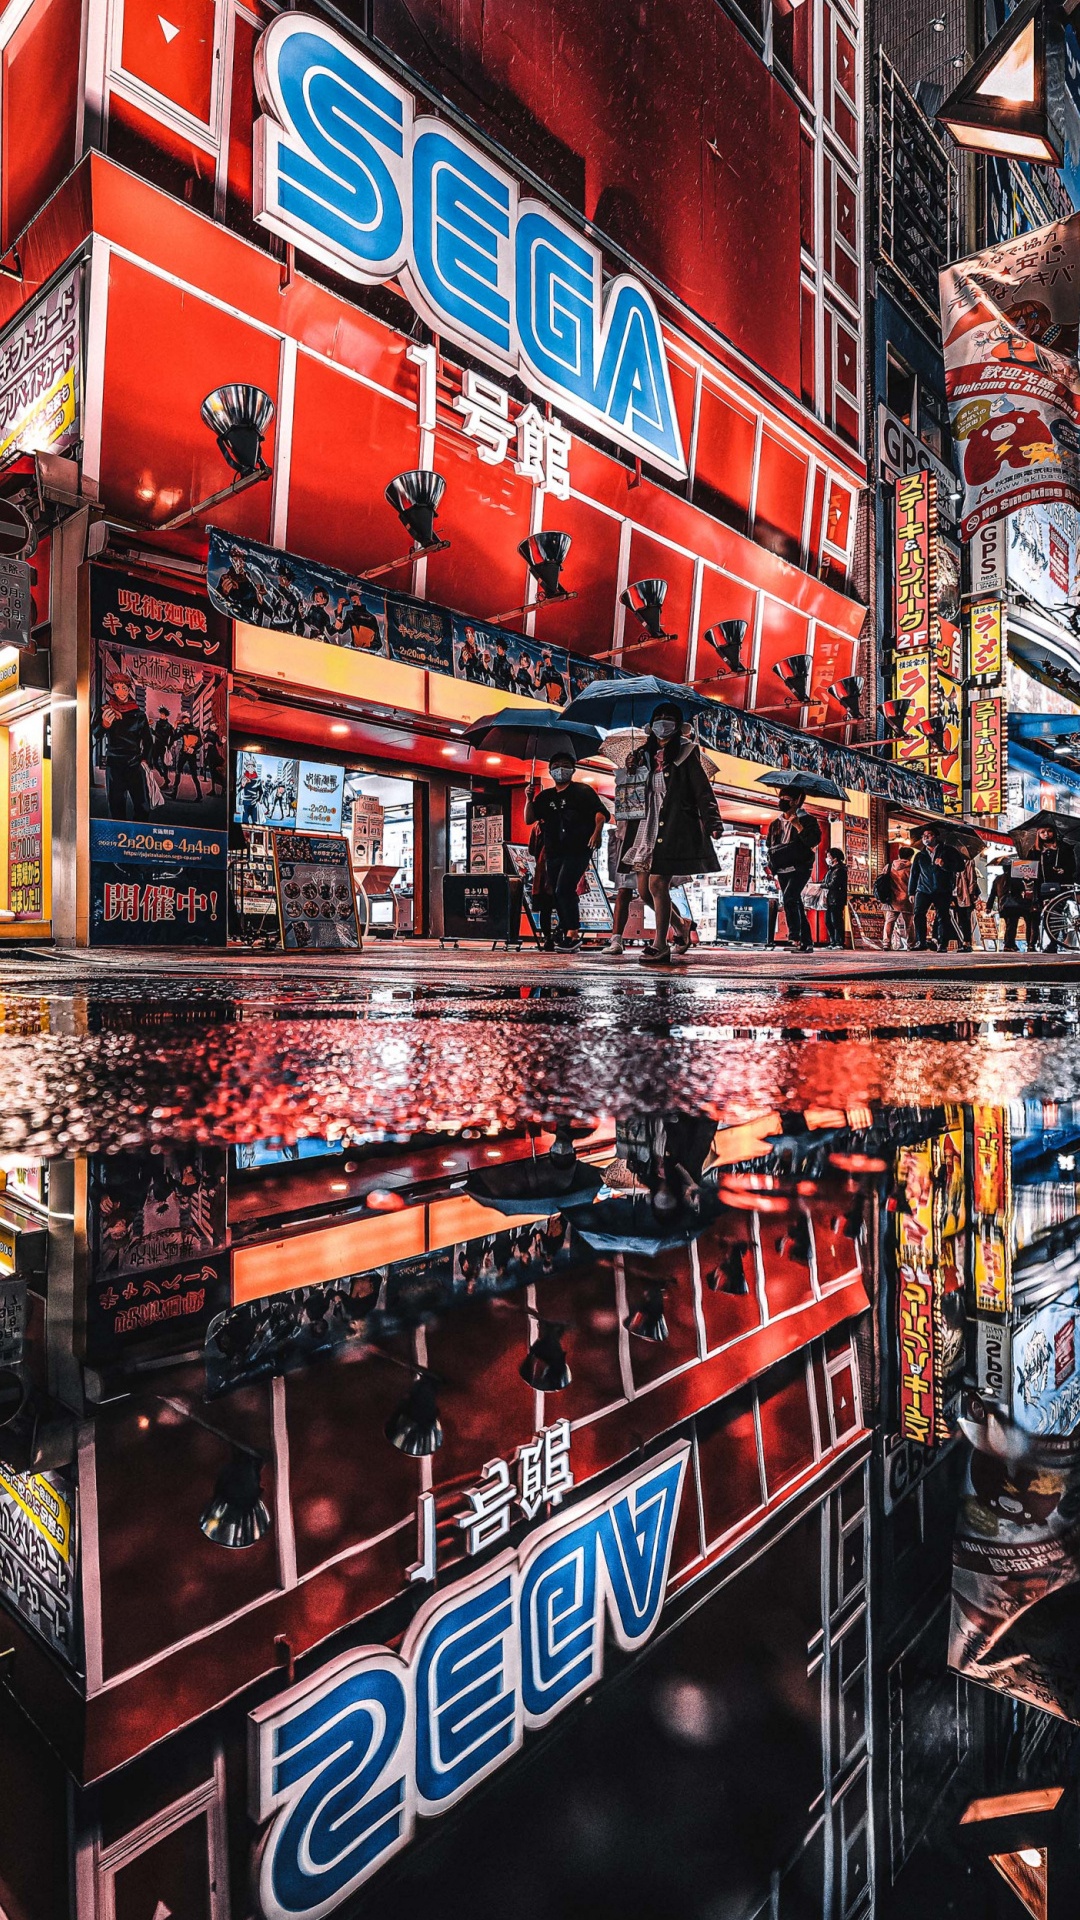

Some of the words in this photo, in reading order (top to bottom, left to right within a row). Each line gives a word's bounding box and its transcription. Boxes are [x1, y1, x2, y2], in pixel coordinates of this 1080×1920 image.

[255, 12, 686, 476] SEGA
[953, 381, 1006, 396] Welcome
[1008, 381, 1022, 390] to
[1022, 384, 1079, 420] AKIHABARA
[406, 344, 572, 501] 1号館
[981, 505, 998, 520] No
[1000, 487, 1063, 511] Smoking
[980, 525, 998, 575] GPS
[980, 573, 998, 581] next
[118, 588, 208, 633] 呪術廻戦
[102, 612, 220, 656] キャンペーン
[897, 630, 928, 649] 2F
[974, 613, 998, 673] ラーメン
[133, 654, 196, 687] 呪術廻戦
[975, 671, 998, 685] 1F
[988, 791, 1000, 812] 2F
[103, 882, 218, 923] 開催中!
